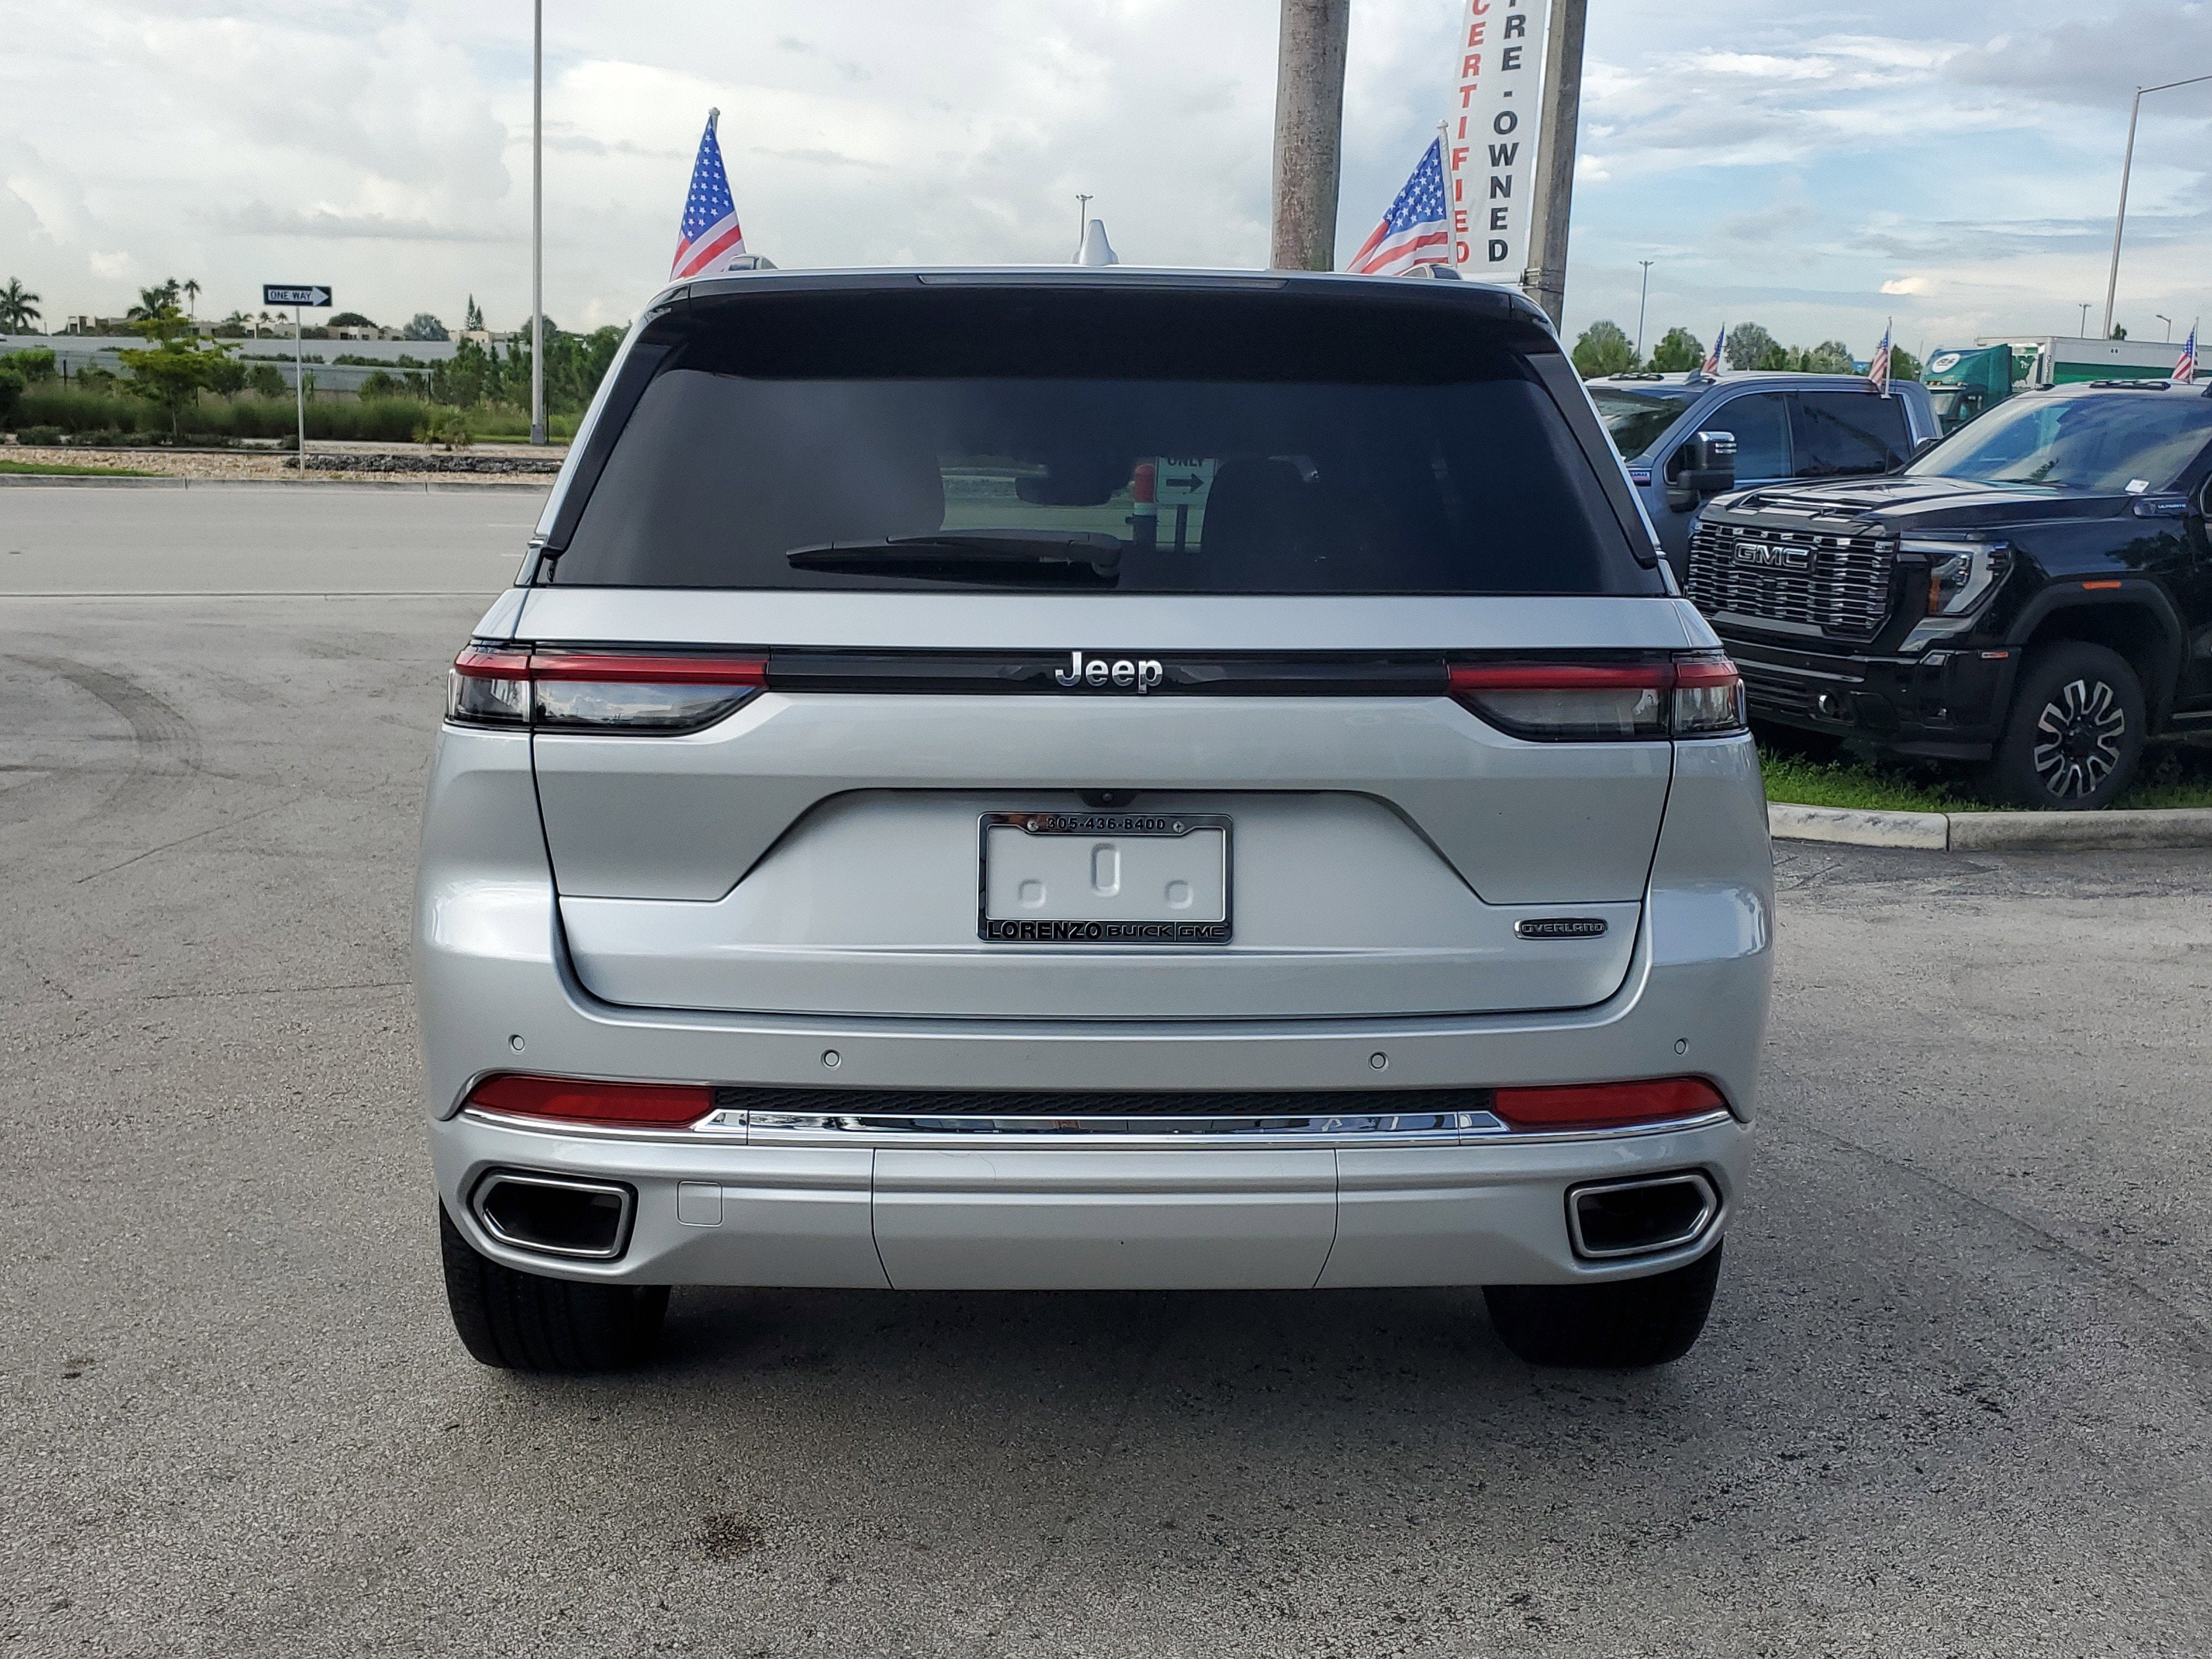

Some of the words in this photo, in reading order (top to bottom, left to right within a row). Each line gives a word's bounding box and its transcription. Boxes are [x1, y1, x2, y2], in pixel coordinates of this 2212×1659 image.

[1488, 0, 1526, 263] RE-OWNED
[270, 291, 290, 300] ONE
[292, 291, 311, 301] WAY
[1734, 543, 1809, 569] GMC
[1054, 651, 1163, 693] Jeep
[1045, 817, 1166, 830] 305-436-8400
[986, 921, 1103, 939] LORENZO
[1107, 924, 1173, 938] BUICK
[1178, 925, 1226, 938] GMC
[1521, 923, 1606, 933] OVERLAND
